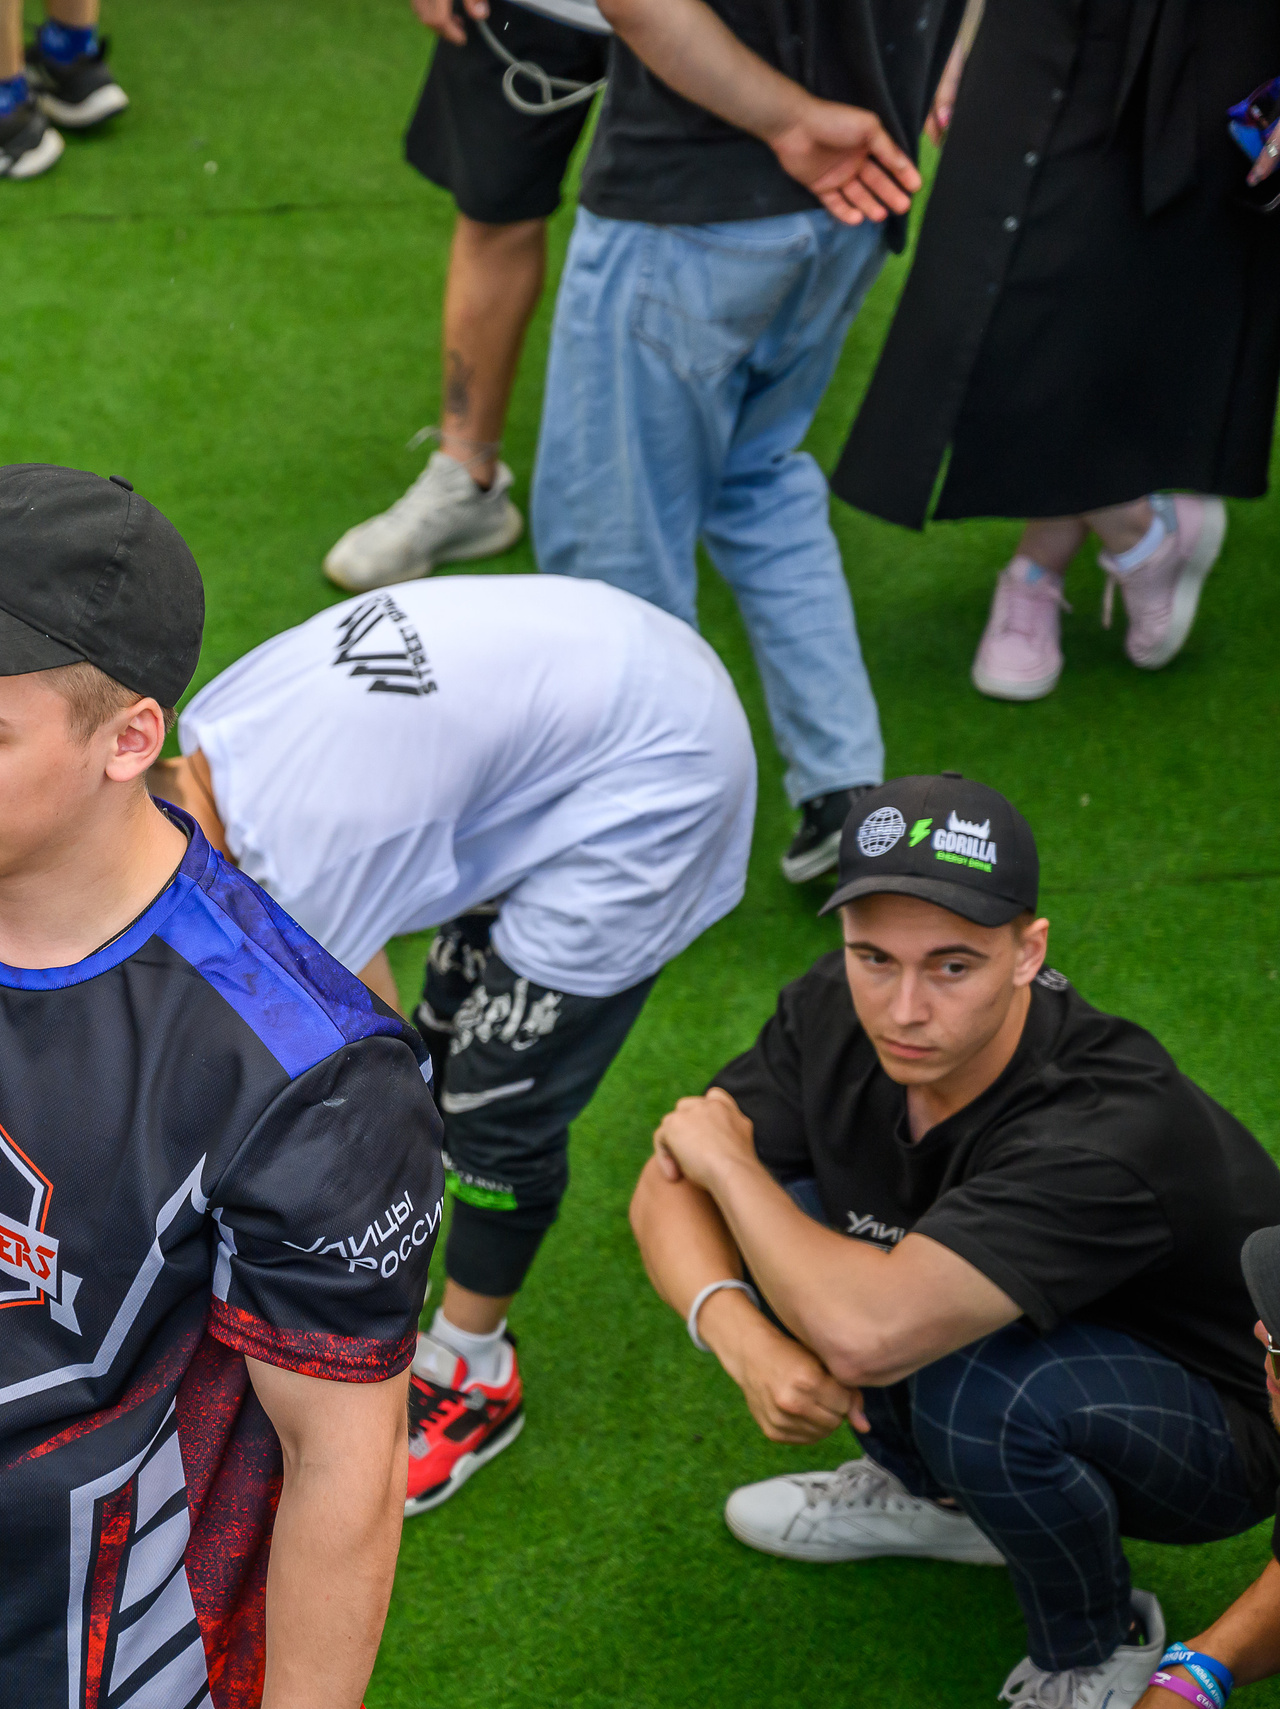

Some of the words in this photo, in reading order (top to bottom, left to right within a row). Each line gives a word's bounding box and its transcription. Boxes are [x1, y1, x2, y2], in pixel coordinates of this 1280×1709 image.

[933, 828, 997, 865] GORILLA
[282, 1190, 414, 1258] УЛИЦЫ
[345, 1196, 444, 1279] РОССИ
